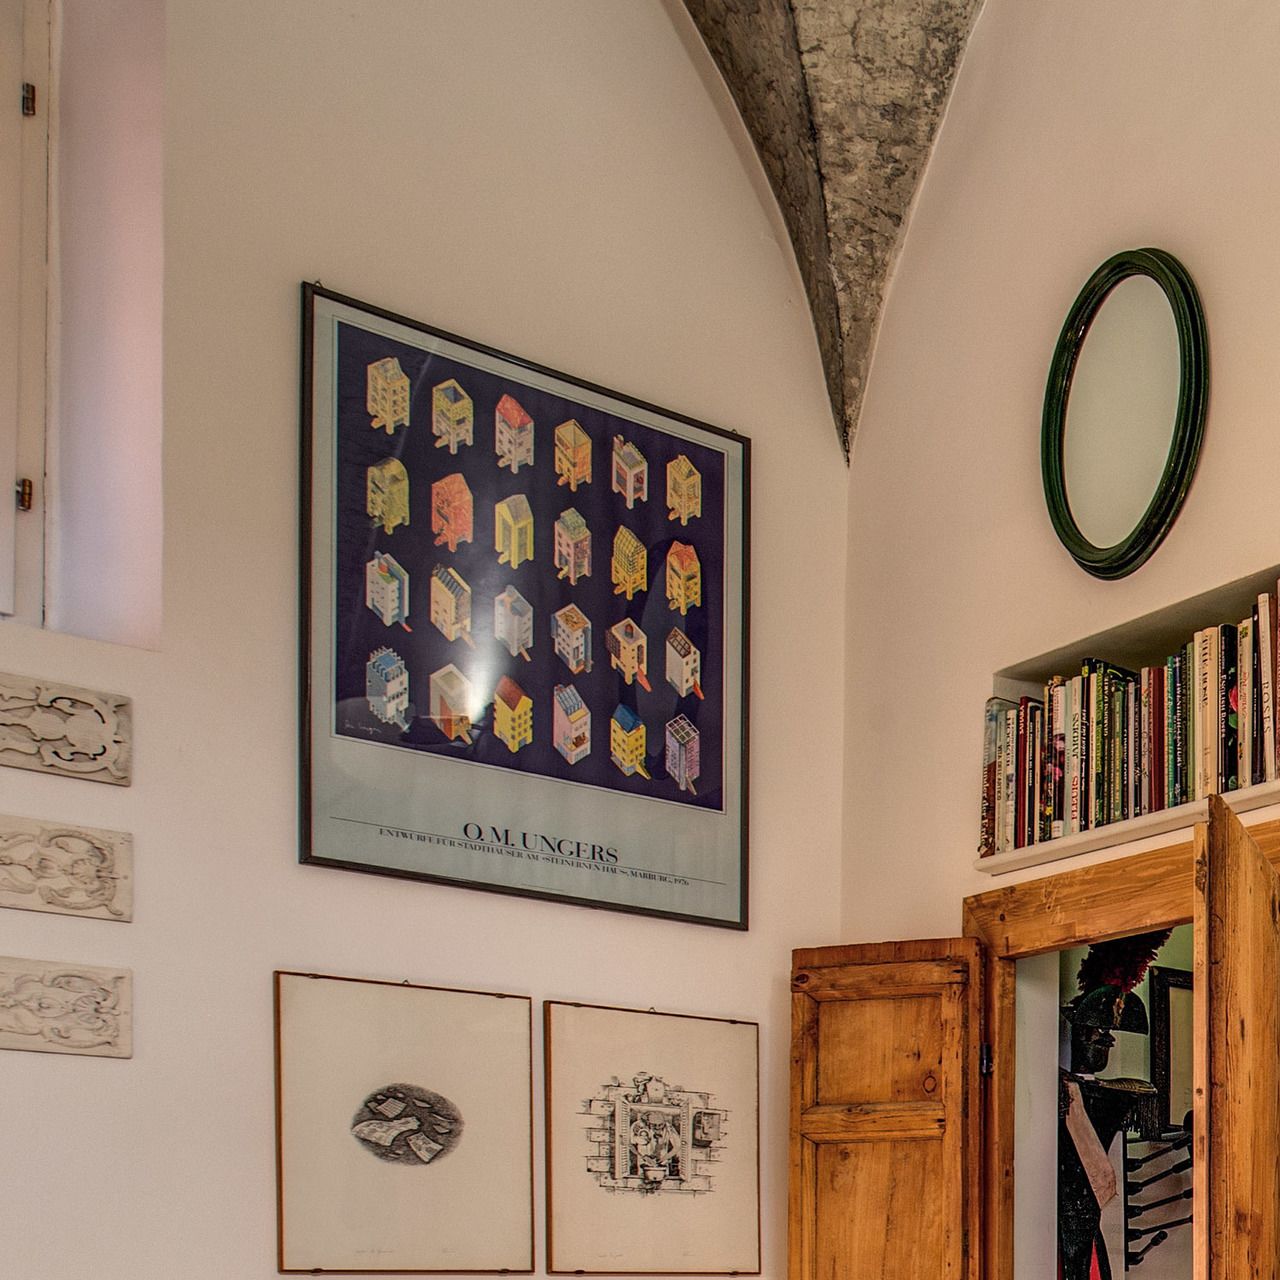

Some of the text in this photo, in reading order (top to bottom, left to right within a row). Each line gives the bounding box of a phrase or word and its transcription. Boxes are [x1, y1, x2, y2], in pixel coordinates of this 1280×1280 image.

[1262, 681, 1271, 734] ROSES
[463, 822, 619, 864] O. M. UNGERS
